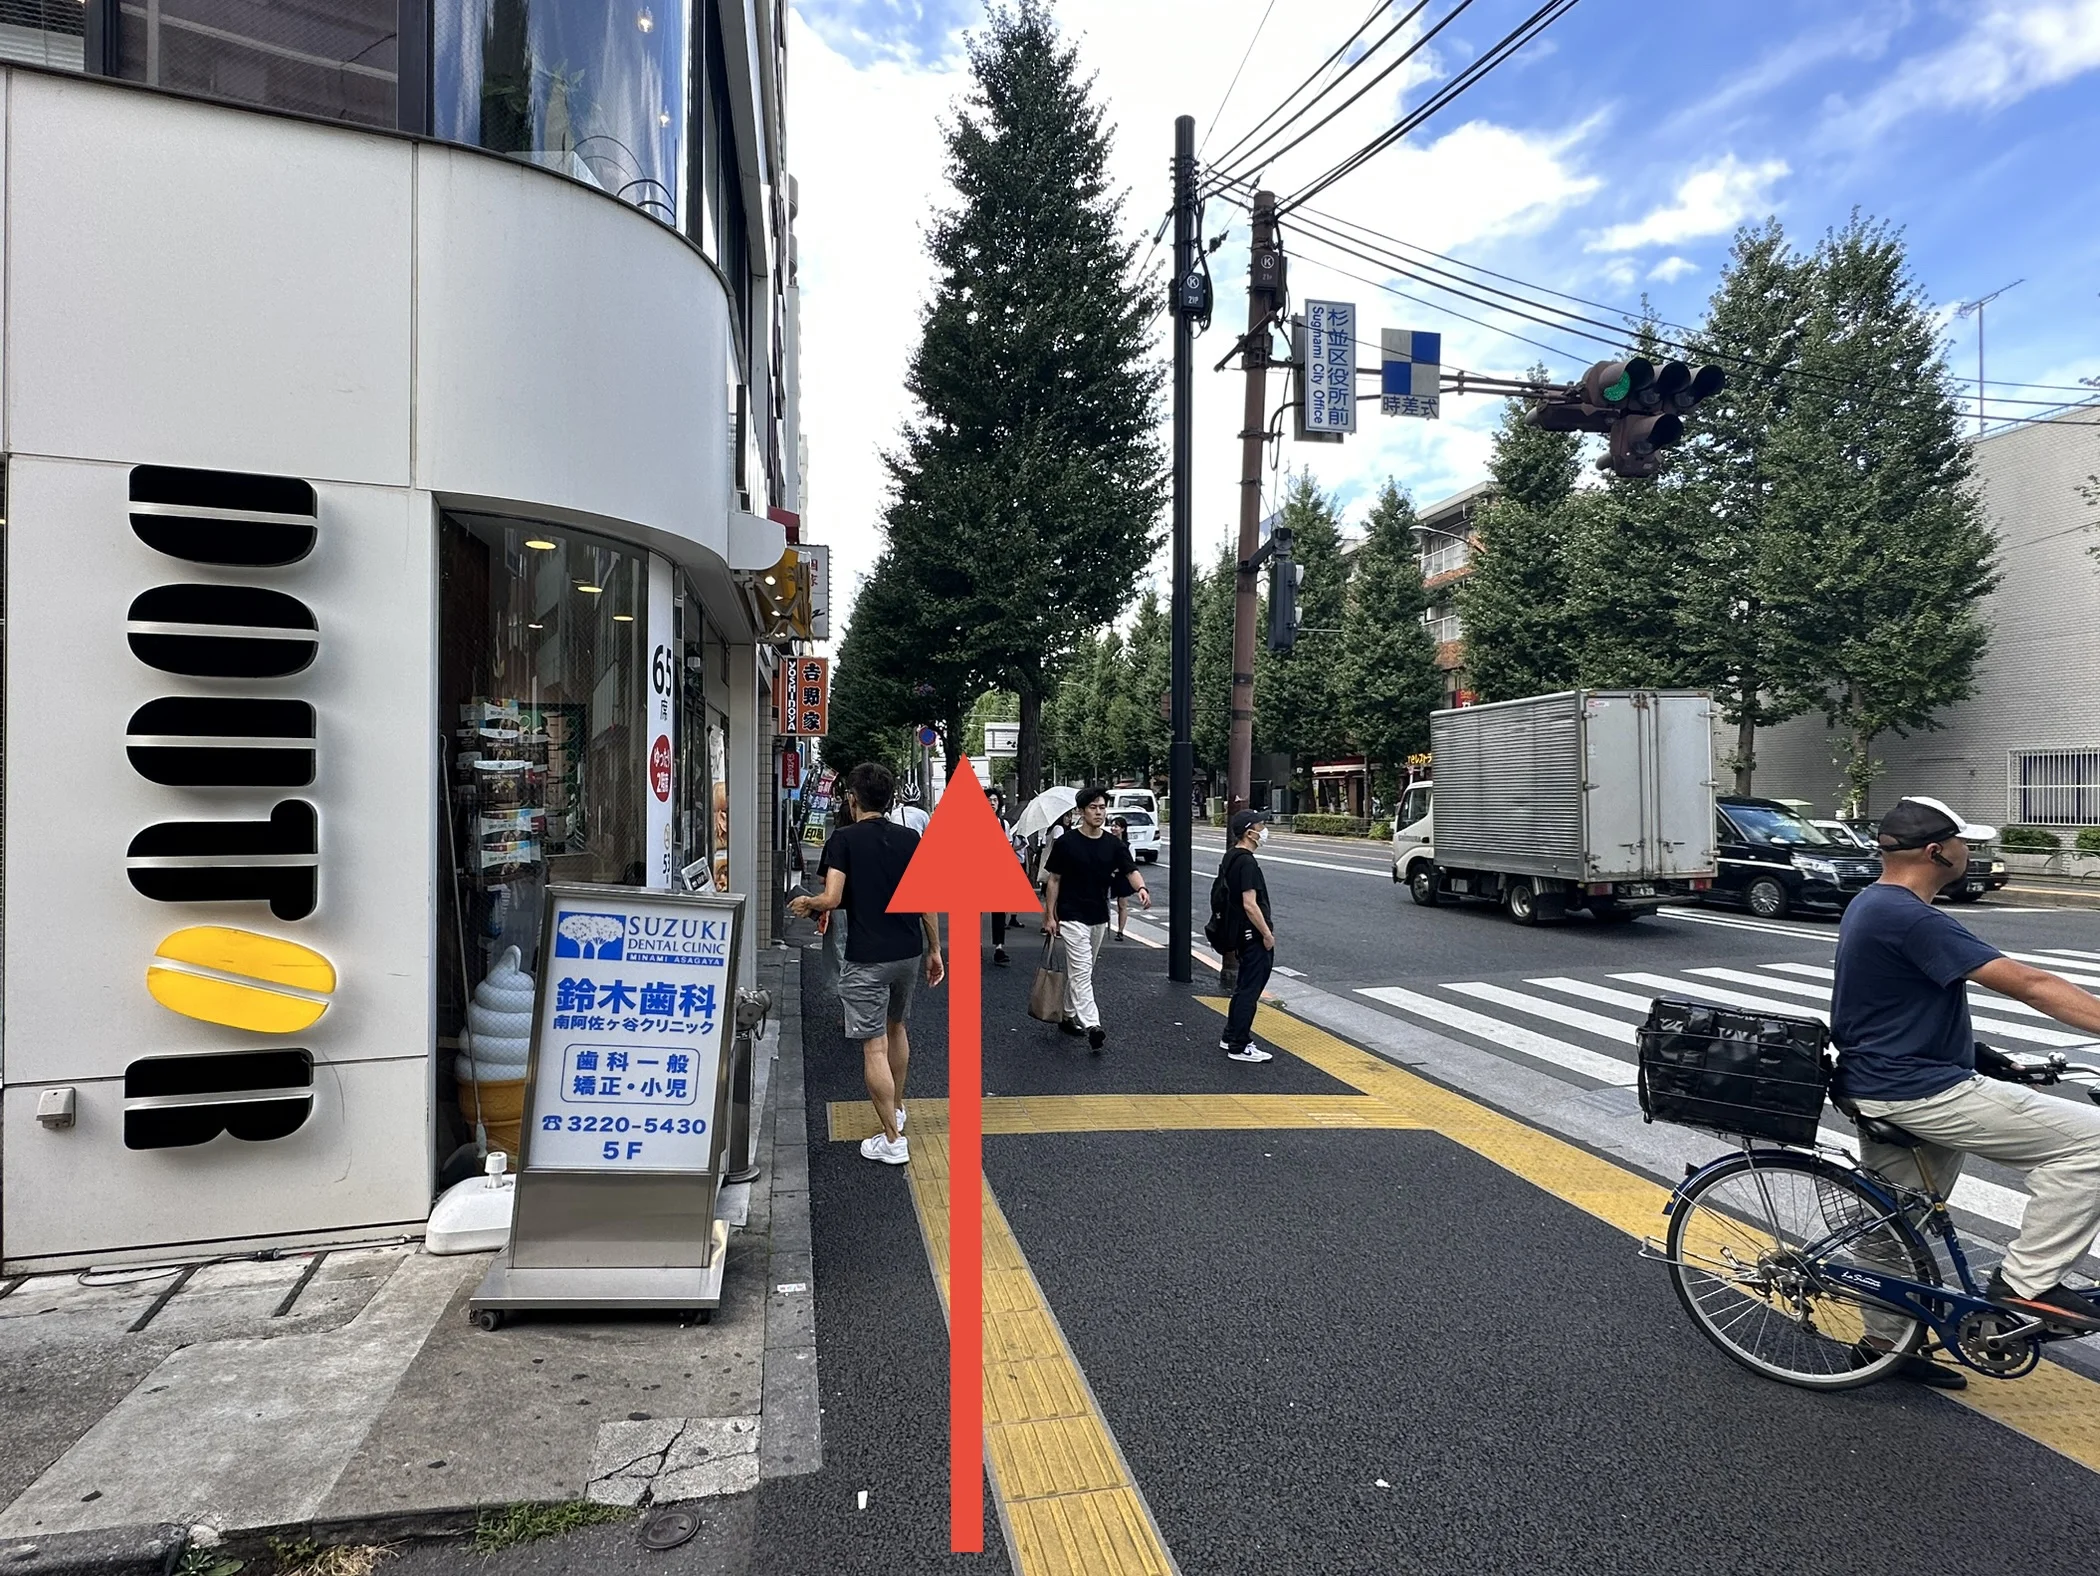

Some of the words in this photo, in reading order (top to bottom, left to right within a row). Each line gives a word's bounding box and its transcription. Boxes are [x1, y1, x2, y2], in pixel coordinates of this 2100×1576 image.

[1311, 363, 1325, 385] City
[1327, 308, 1349, 426] 杉並区役所前
[1313, 391, 1325, 424] Office
[1383, 396, 1439, 418] 時差式
[628, 915, 727, 941] SUZUKI
[628, 938, 679, 953] DENTAL
[682, 941, 726, 956] CLINIC
[629, 953, 668, 963] MINAMI
[673, 956, 723, 967] ASAGAYA
[555, 977, 717, 1018] 鈴木歯科
[575, 1050, 690, 1075] 歯科一般
[573, 1075, 689, 1099] 矯正・小児
[567, 1115, 707, 1135] 3220-5430
